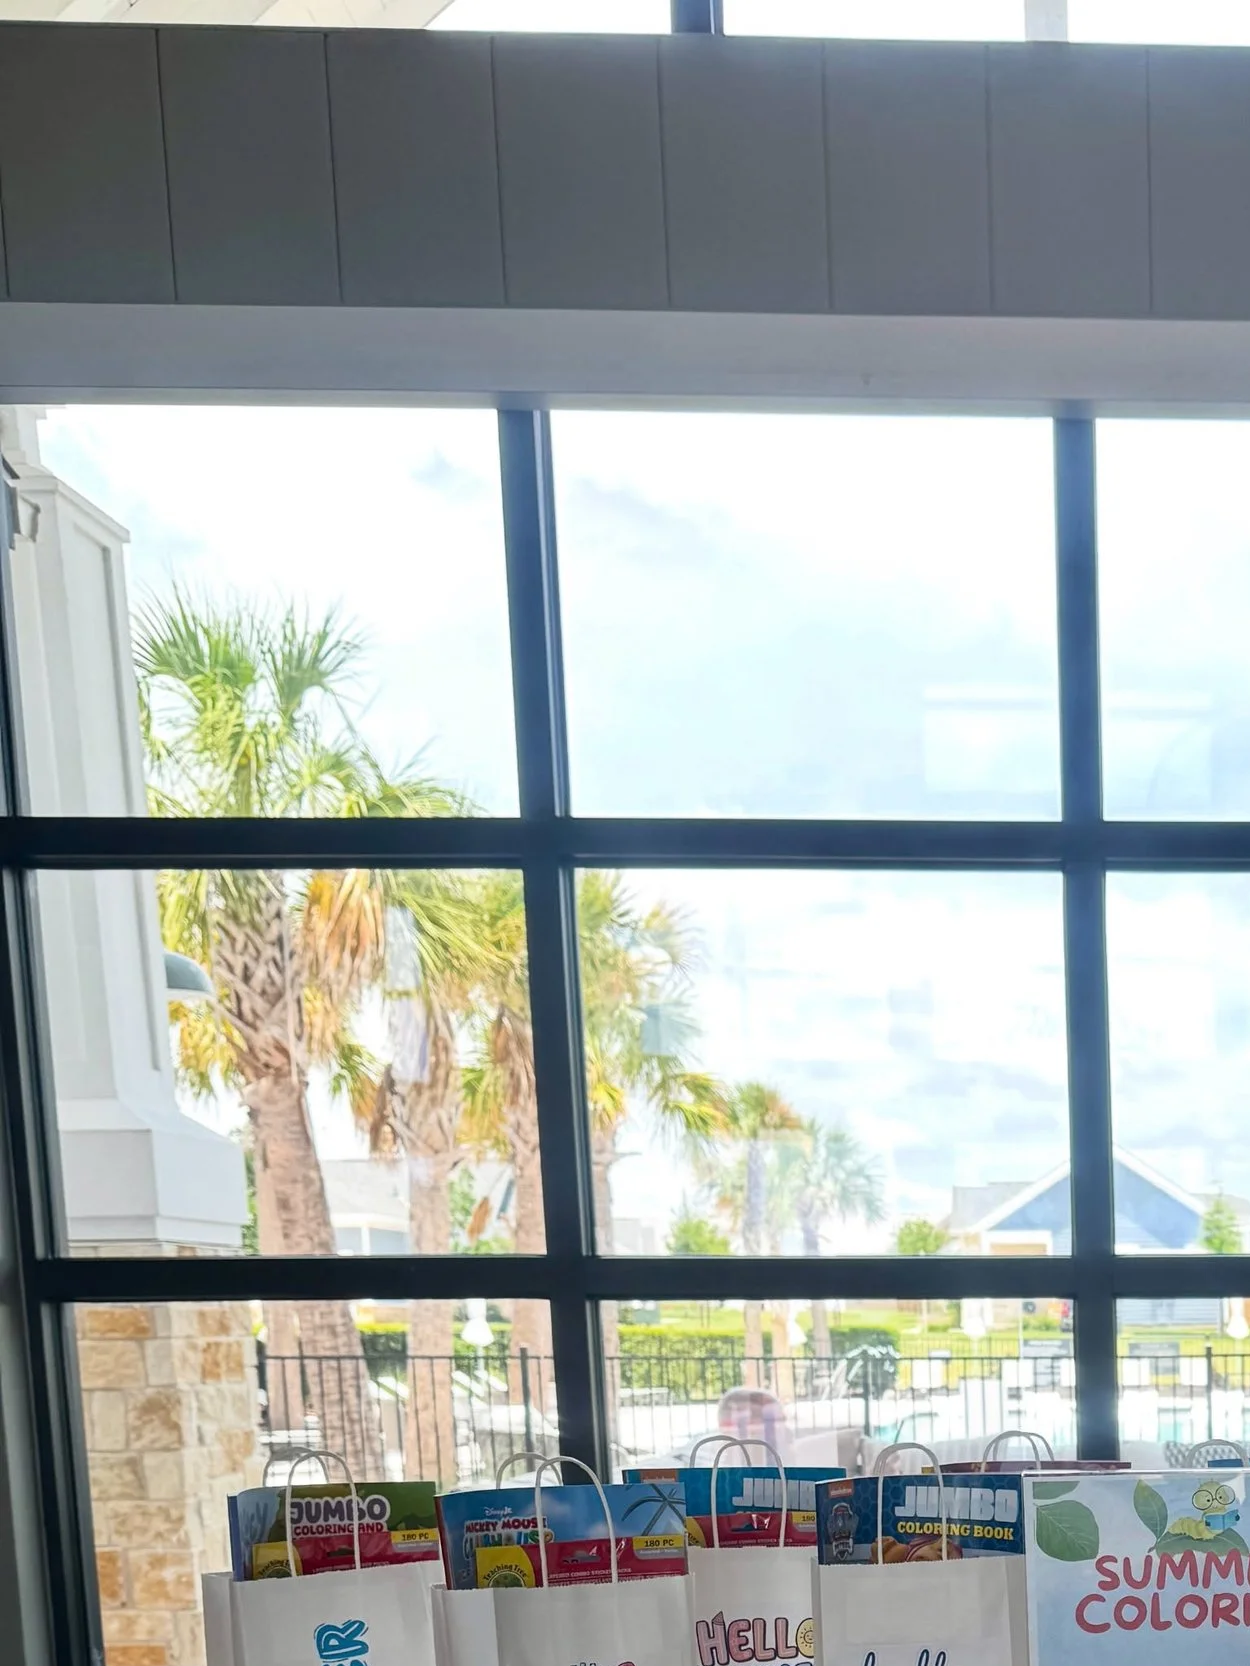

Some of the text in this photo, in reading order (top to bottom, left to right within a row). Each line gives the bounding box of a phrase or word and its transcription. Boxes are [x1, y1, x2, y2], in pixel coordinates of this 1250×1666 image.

[732, 1477, 816, 1510] JUMB
[290, 1497, 388, 1525] JUMBO
[894, 1485, 1019, 1523] JUMBO
[293, 1521, 384, 1537] COLORING AND
[465, 1520, 499, 1534] MICKEY
[973, 1525, 1014, 1541] BOOK
[401, 1532, 430, 1542] 180 PC
[644, 1538, 675, 1548] 180 PC
